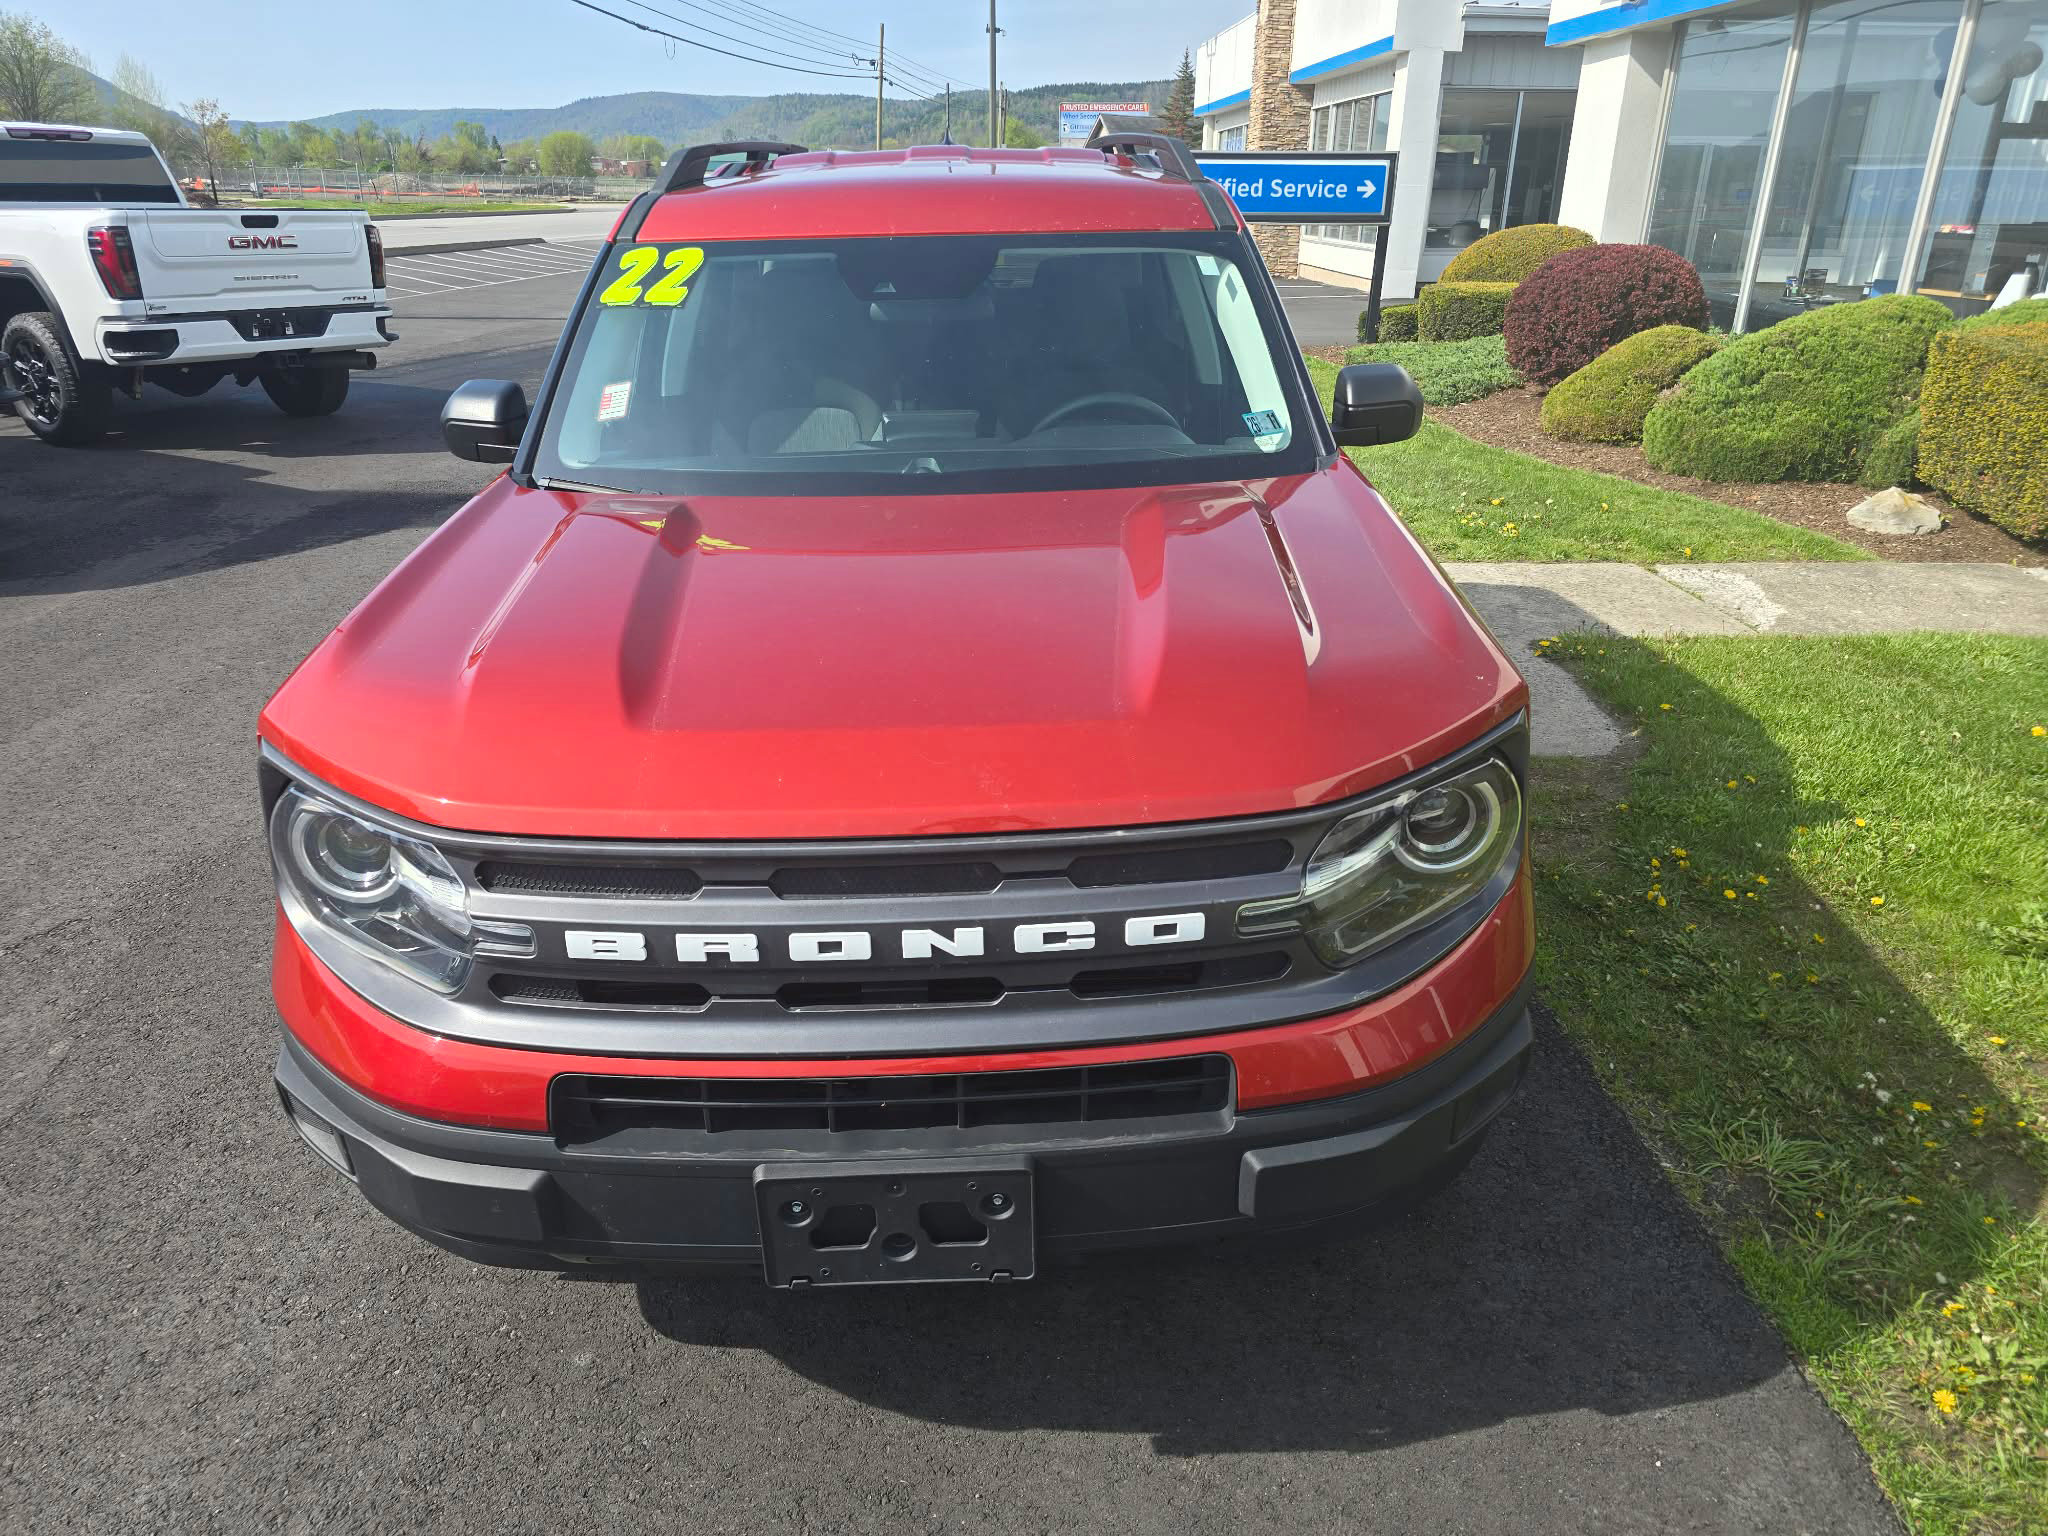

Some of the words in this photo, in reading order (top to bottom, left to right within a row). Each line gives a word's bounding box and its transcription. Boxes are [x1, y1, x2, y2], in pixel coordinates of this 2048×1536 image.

[1270, 178, 1348, 198] Service
[227, 234, 298, 249] GMC
[600, 247, 704, 306] 22
[564, 911, 1206, 963] BRONCO
